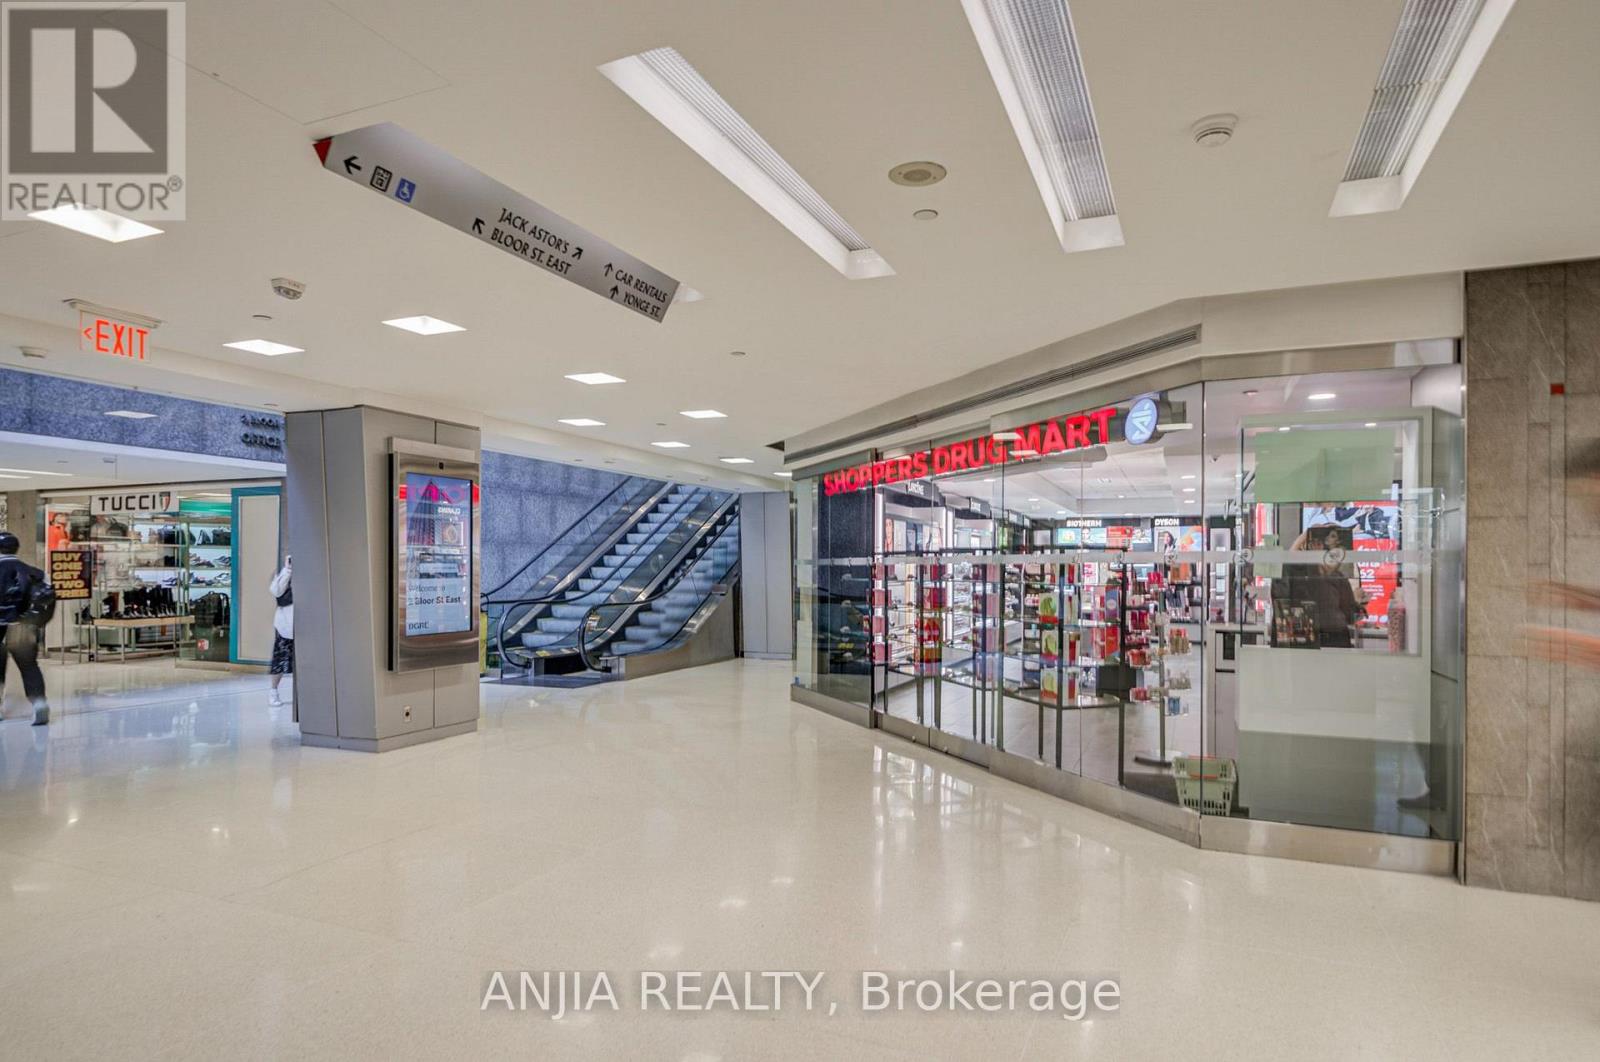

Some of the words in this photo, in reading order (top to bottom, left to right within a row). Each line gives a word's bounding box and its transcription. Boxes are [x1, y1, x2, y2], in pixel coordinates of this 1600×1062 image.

[498, 208, 530, 233] JACK
[490, 227, 530, 256] BLOOR
[529, 247, 544, 263] ST.
[545, 255, 573, 275] EAST
[614, 269, 634, 287] CAR
[634, 278, 668, 303] RENTALS
[623, 291, 650, 312] YONGE
[96, 319, 149, 360] EXIT
[823, 452, 929, 496] SHOPPERS
[933, 433, 1007, 473] DRUG
[1014, 408, 1117, 459] MART
[98, 495, 156, 511] TUCCI
[52, 552, 82, 562] BUY
[52, 562, 83, 571] ONE
[52, 571, 81, 580] GET
[52, 579, 85, 589] TWO
[436, 596, 445, 604] St
[446, 596, 461, 604] East
